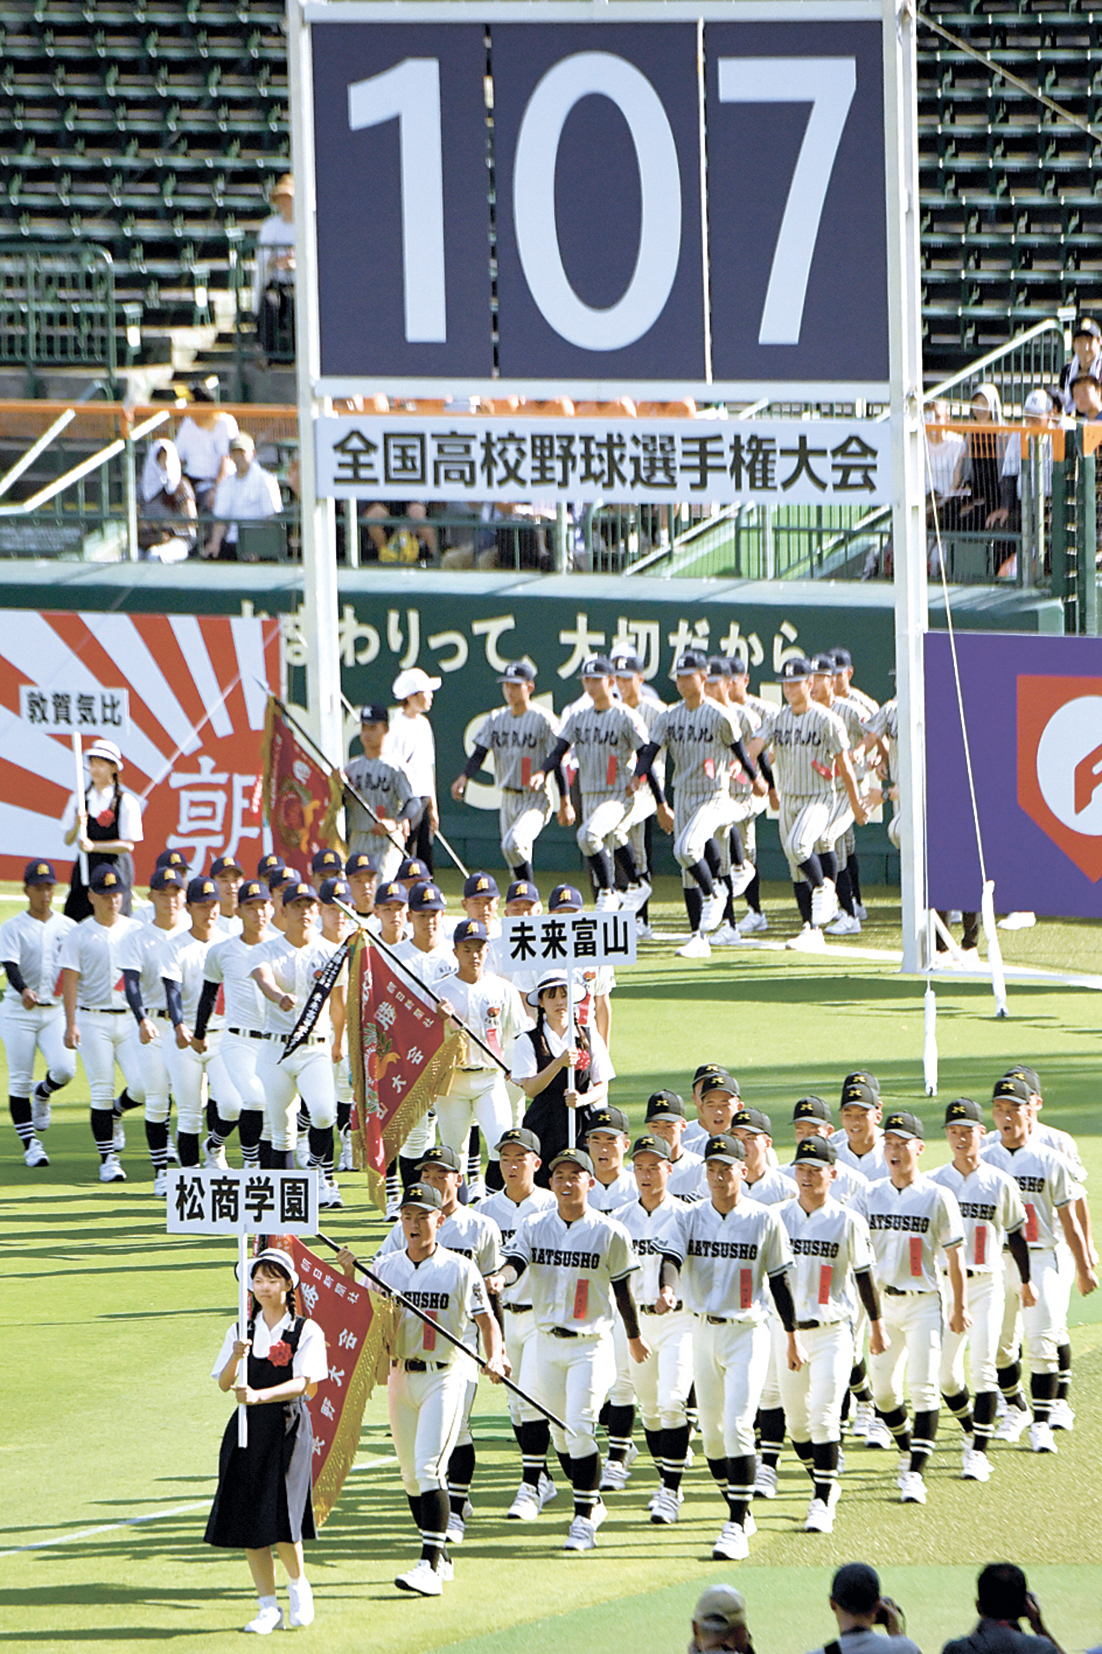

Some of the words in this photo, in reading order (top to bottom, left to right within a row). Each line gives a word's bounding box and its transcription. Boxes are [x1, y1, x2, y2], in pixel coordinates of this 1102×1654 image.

[348, 51, 856, 351] 107
[332, 429, 878, 493] 全国高校野球選手権大会
[240, 600, 806, 683] まわりって、大切だから
[26, 691, 122, 727] 敦賀気比
[509, 916, 629, 961] 未来富山
[175, 1174, 310, 1224] 松商学園
